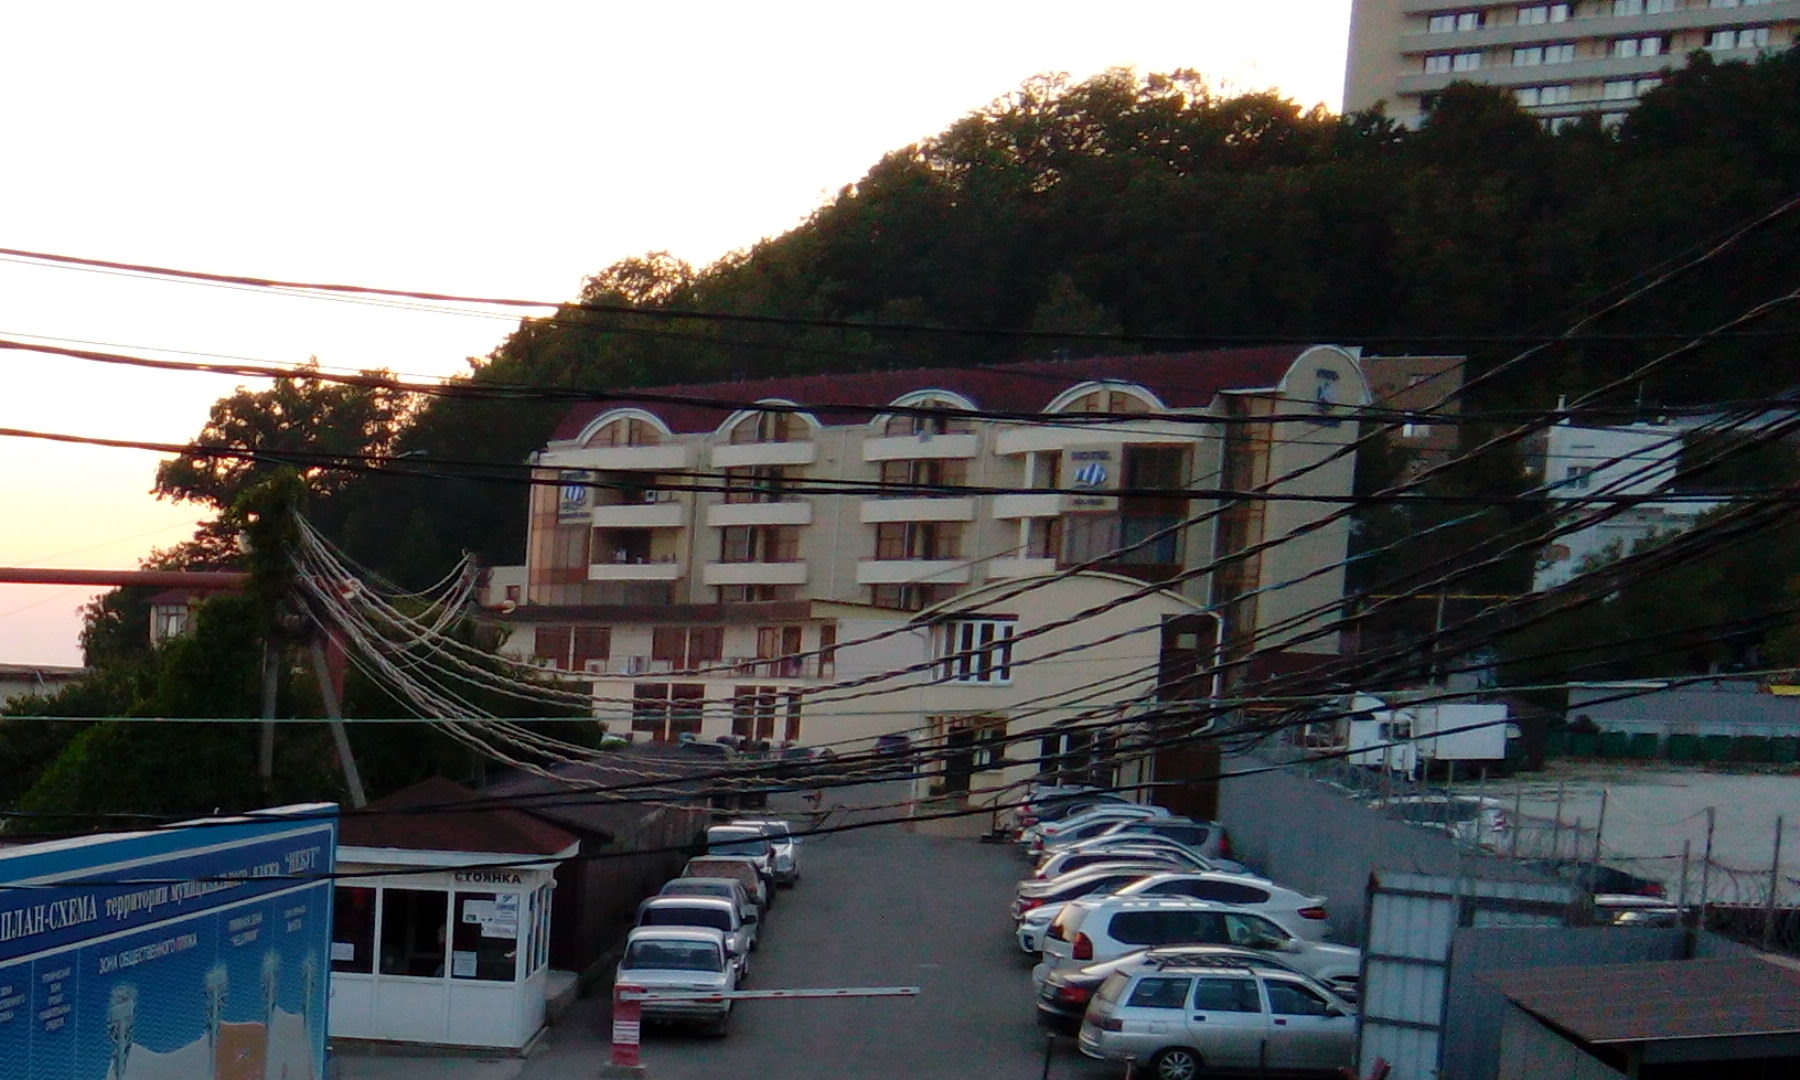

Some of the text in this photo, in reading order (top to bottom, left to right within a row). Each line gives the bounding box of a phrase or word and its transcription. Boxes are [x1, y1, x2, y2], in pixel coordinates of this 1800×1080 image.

[455, 871, 522, 884] СТОЯНКА
[0, 893, 97, 943] ПЛАН-СХЕМА
[104, 885, 168, 922] территории
